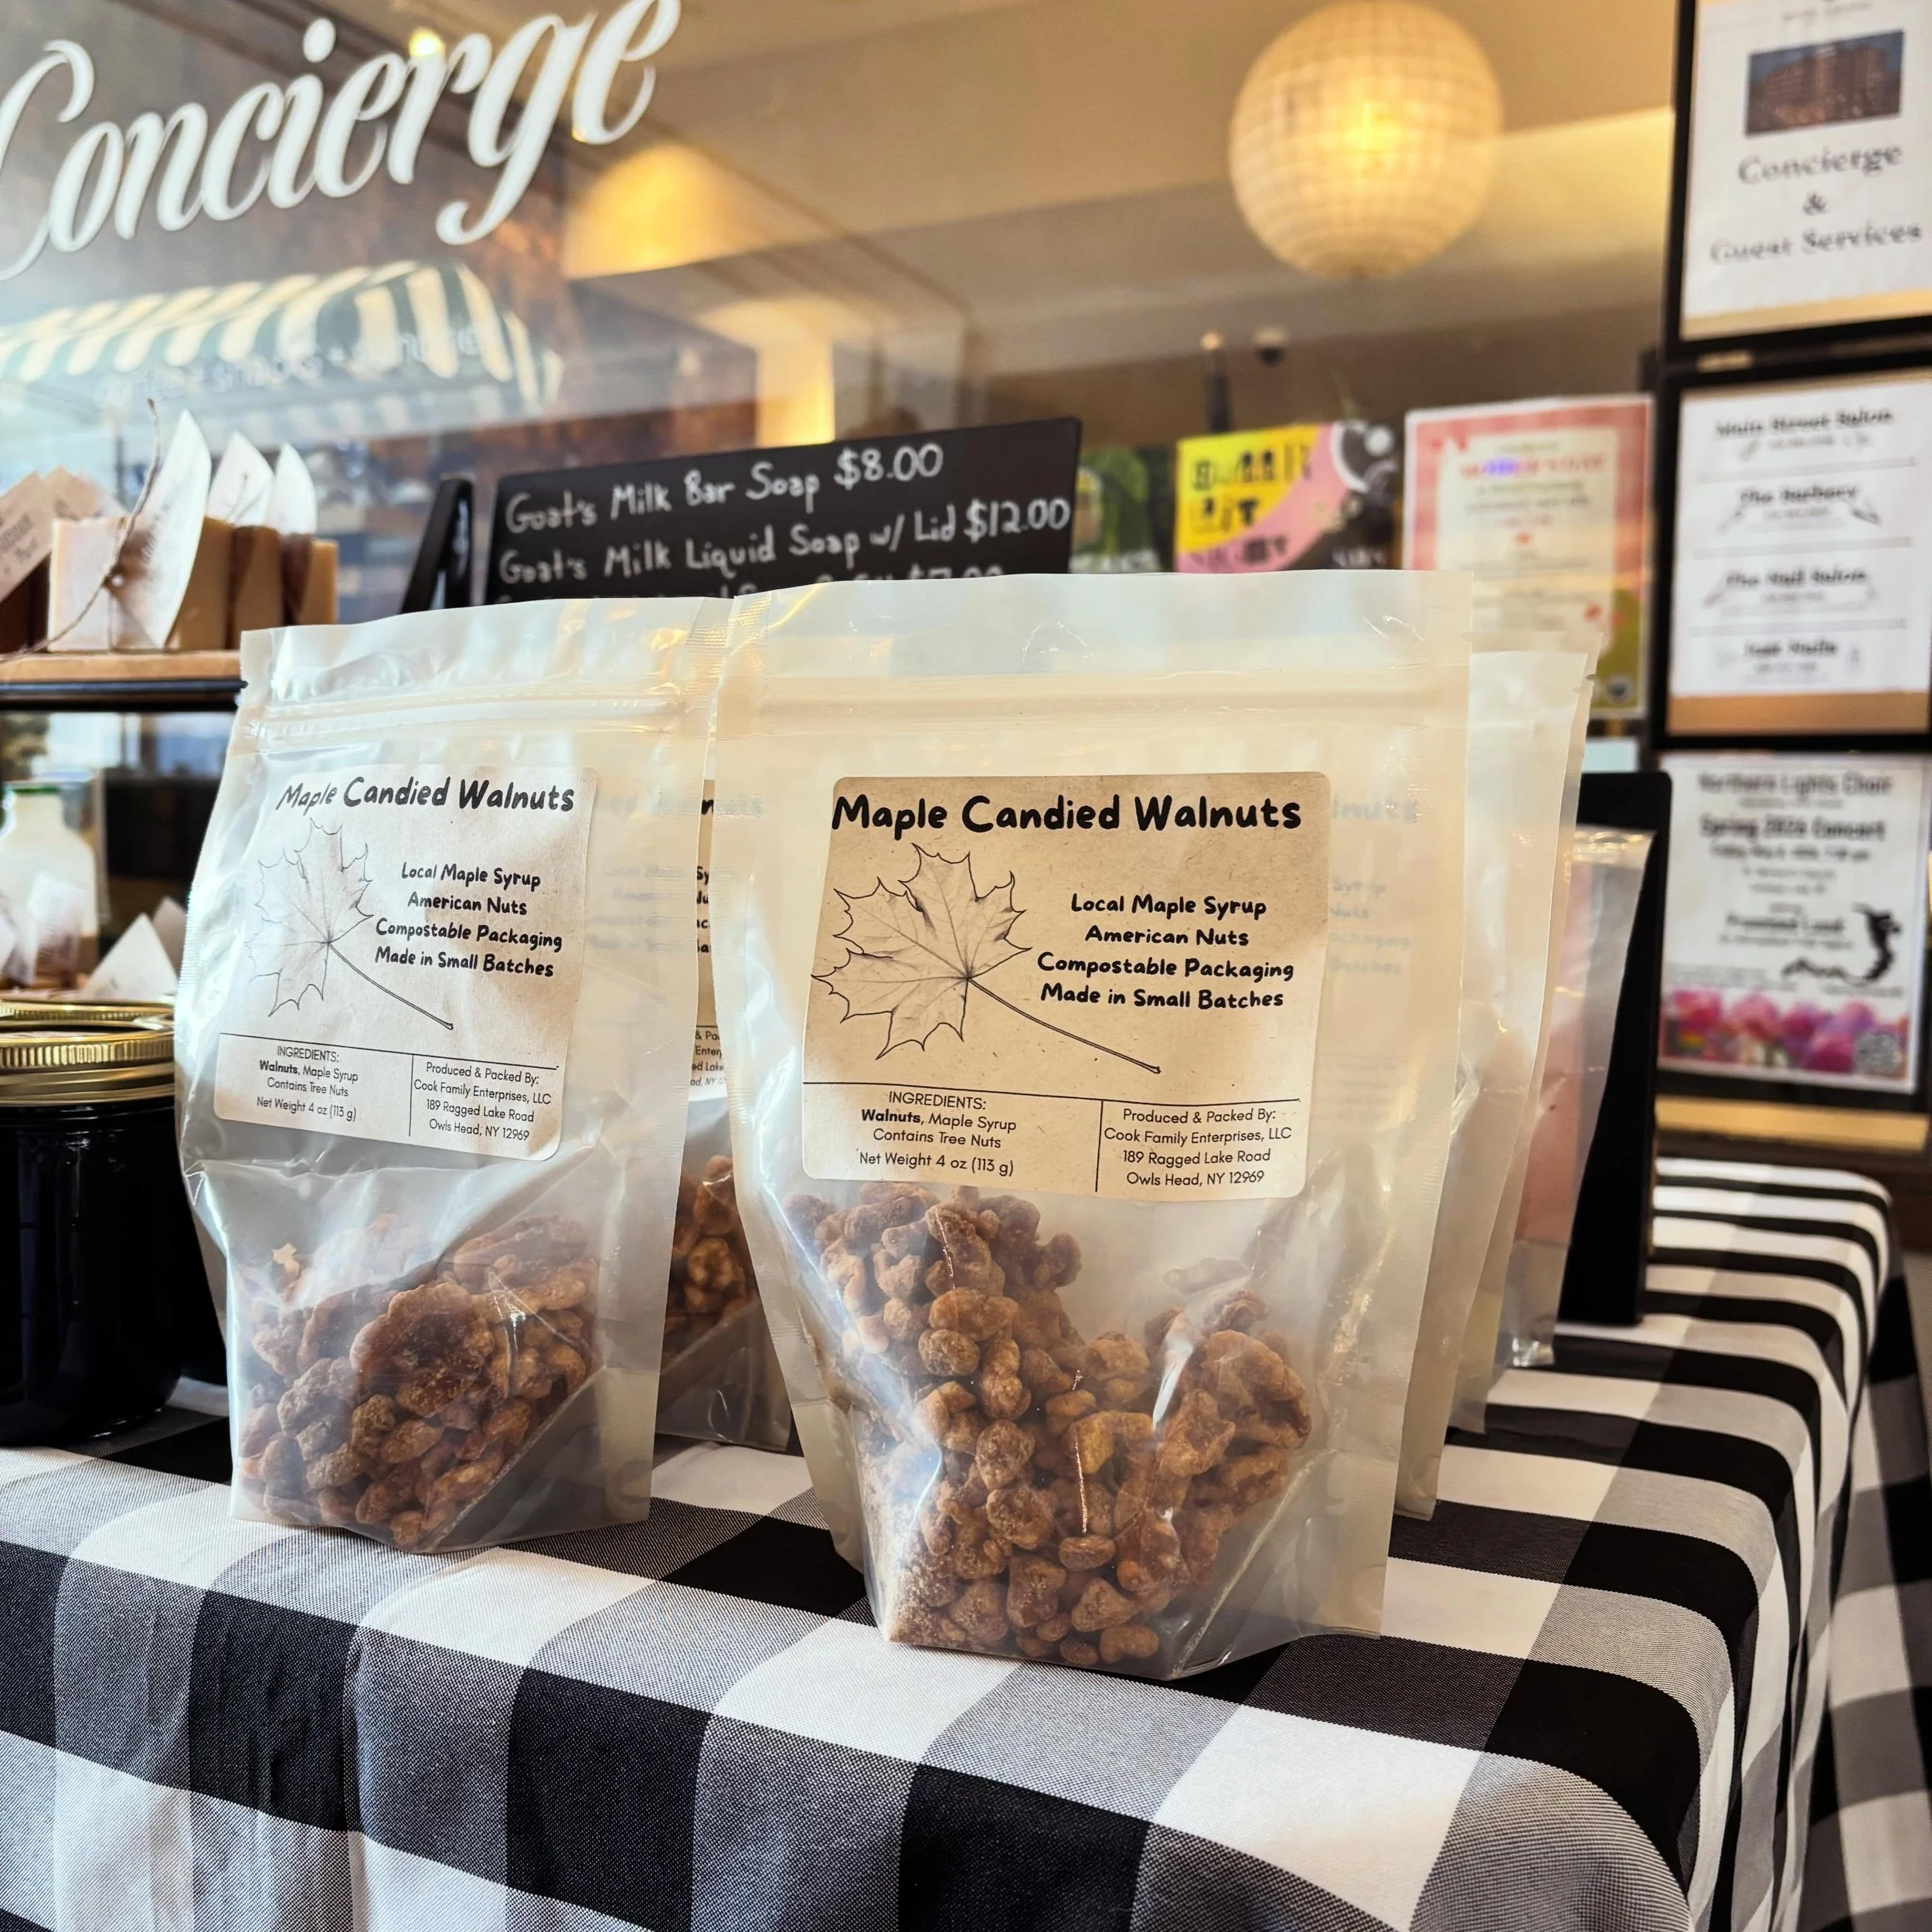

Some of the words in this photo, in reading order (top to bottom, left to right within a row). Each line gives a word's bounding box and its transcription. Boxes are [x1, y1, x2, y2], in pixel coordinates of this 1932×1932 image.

[0, 0, 682, 283] Concierge
[1738, 145, 1903, 185] Concierge
[1802, 191, 1828, 215] &
[1801, 221, 1922, 254] Services
[611, 481, 672, 520] Milk
[684, 468, 736, 506] Bar
[745, 461, 820, 514] Soap
[833, 443, 944, 492] $8.00
[604, 539, 672, 577] Milk
[685, 523, 776, 579] Liquid
[788, 522, 859, 570] Soap
[869, 514, 905, 553] w/
[914, 503, 957, 542] Lid
[963, 497, 1070, 543] $12.00
[275, 782, 338, 816] Maple
[343, 776, 451, 808] Candied
[458, 779, 575, 812] Walnuts
[832, 794, 947, 841] Maple
[961, 794, 1120, 833] Candied
[1134, 794, 1302, 832] Walnuts
[401, 862, 437, 879] Local
[440, 863, 488, 888] Maple
[494, 867, 540, 892] Syrup
[407, 891, 481, 910] American
[487, 896, 527, 915] Nuts
[1071, 893, 1124, 912] Local
[1131, 893, 1196, 920] Maple
[1204, 896, 1267, 921] Syrup
[376, 917, 471, 941] Compostable
[476, 924, 563, 953] Packaging
[1084, 924, 1189, 944] American
[1196, 927, 1249, 947] Nuts
[375, 946, 416, 964] Made
[420, 951, 433, 965] in
[438, 951, 478, 970] Small
[482, 953, 554, 978] Batches
[1037, 951, 1177, 978] Compostable
[1184, 957, 1294, 983] Packaging
[1040, 982, 1100, 1003] Made
[1107, 988, 1126, 1005] in
[1134, 988, 1190, 1008] Small
[1198, 988, 1284, 1009] Batches
[277, 1046, 339, 1063] INGREDIENTS:
[259, 1060, 301, 1076] Walnuts,
[302, 1067, 331, 1080] Maple
[333, 1068, 359, 1085] Syrup
[427, 1062, 471, 1077] Produced
[474, 1068, 481, 1078] &
[485, 1068, 522, 1083] Packed
[525, 1073, 539, 1087] By:
[267, 1077, 307, 1092] Contains
[309, 1082, 327, 1094] Tree
[329, 1084, 349, 1097] Nuts
[413, 1079, 438, 1092] Cook
[440, 1082, 471, 1099] Family
[473, 1086, 529, 1104] Enterprises,
[532, 1093, 552, 1104] LLC
[257, 1096, 272, 1107] Net
[274, 1098, 306, 1114] Weight
[308, 1103, 315, 1112] 4
[317, 1106, 328, 1115] oz
[330, 1104, 344, 1118] (113
[346, 1107, 357, 1122] g)
[427, 1099, 441, 1111] 189
[443, 1100, 480, 1118] Ragged
[484, 1106, 505, 1119] Lake
[509, 1109, 535, 1122] Road
[889, 1090, 986, 1110] INGREDIENTS:
[862, 1108, 924, 1125] Walnuts,
[928, 1113, 973, 1129] Maple
[977, 1116, 1016, 1134] Syrup
[1124, 1108, 1188, 1124] Produced
[1192, 1112, 1202, 1124] &
[1206, 1108, 1253, 1122] Packed
[1258, 1108, 1276, 1123] By:
[429, 1118, 451, 1131] Owls
[454, 1122, 483, 1137] Head,
[485, 1126, 500, 1137] NY
[502, 1127, 530, 1141] 12969
[873, 1128, 934, 1143] Contains
[939, 1131, 966, 1145] Tree
[971, 1134, 1002, 1148] Nuts
[1104, 1128, 1140, 1142] Cook
[1145, 1131, 1188, 1148] Family
[1191, 1131, 1264, 1145] Enterprises,
[1268, 1127, 1292, 1140] LLC
[859, 1152, 881, 1165] Net
[885, 1152, 932, 1169] Weight
[936, 1155, 946, 1167] 4
[951, 1158, 968, 1169] oz
[971, 1157, 995, 1174] (113
[999, 1160, 1013, 1176] g)
[1123, 1150, 1144, 1163] 189
[1148, 1151, 1199, 1168] Ragged
[1204, 1151, 1233, 1164] Lake
[1237, 1148, 1270, 1162] Road
[1127, 1172, 1161, 1185] Owls
[1165, 1174, 1202, 1186] Head,
[1206, 1172, 1225, 1185] NY
[1229, 1170, 1264, 1184] 12969
